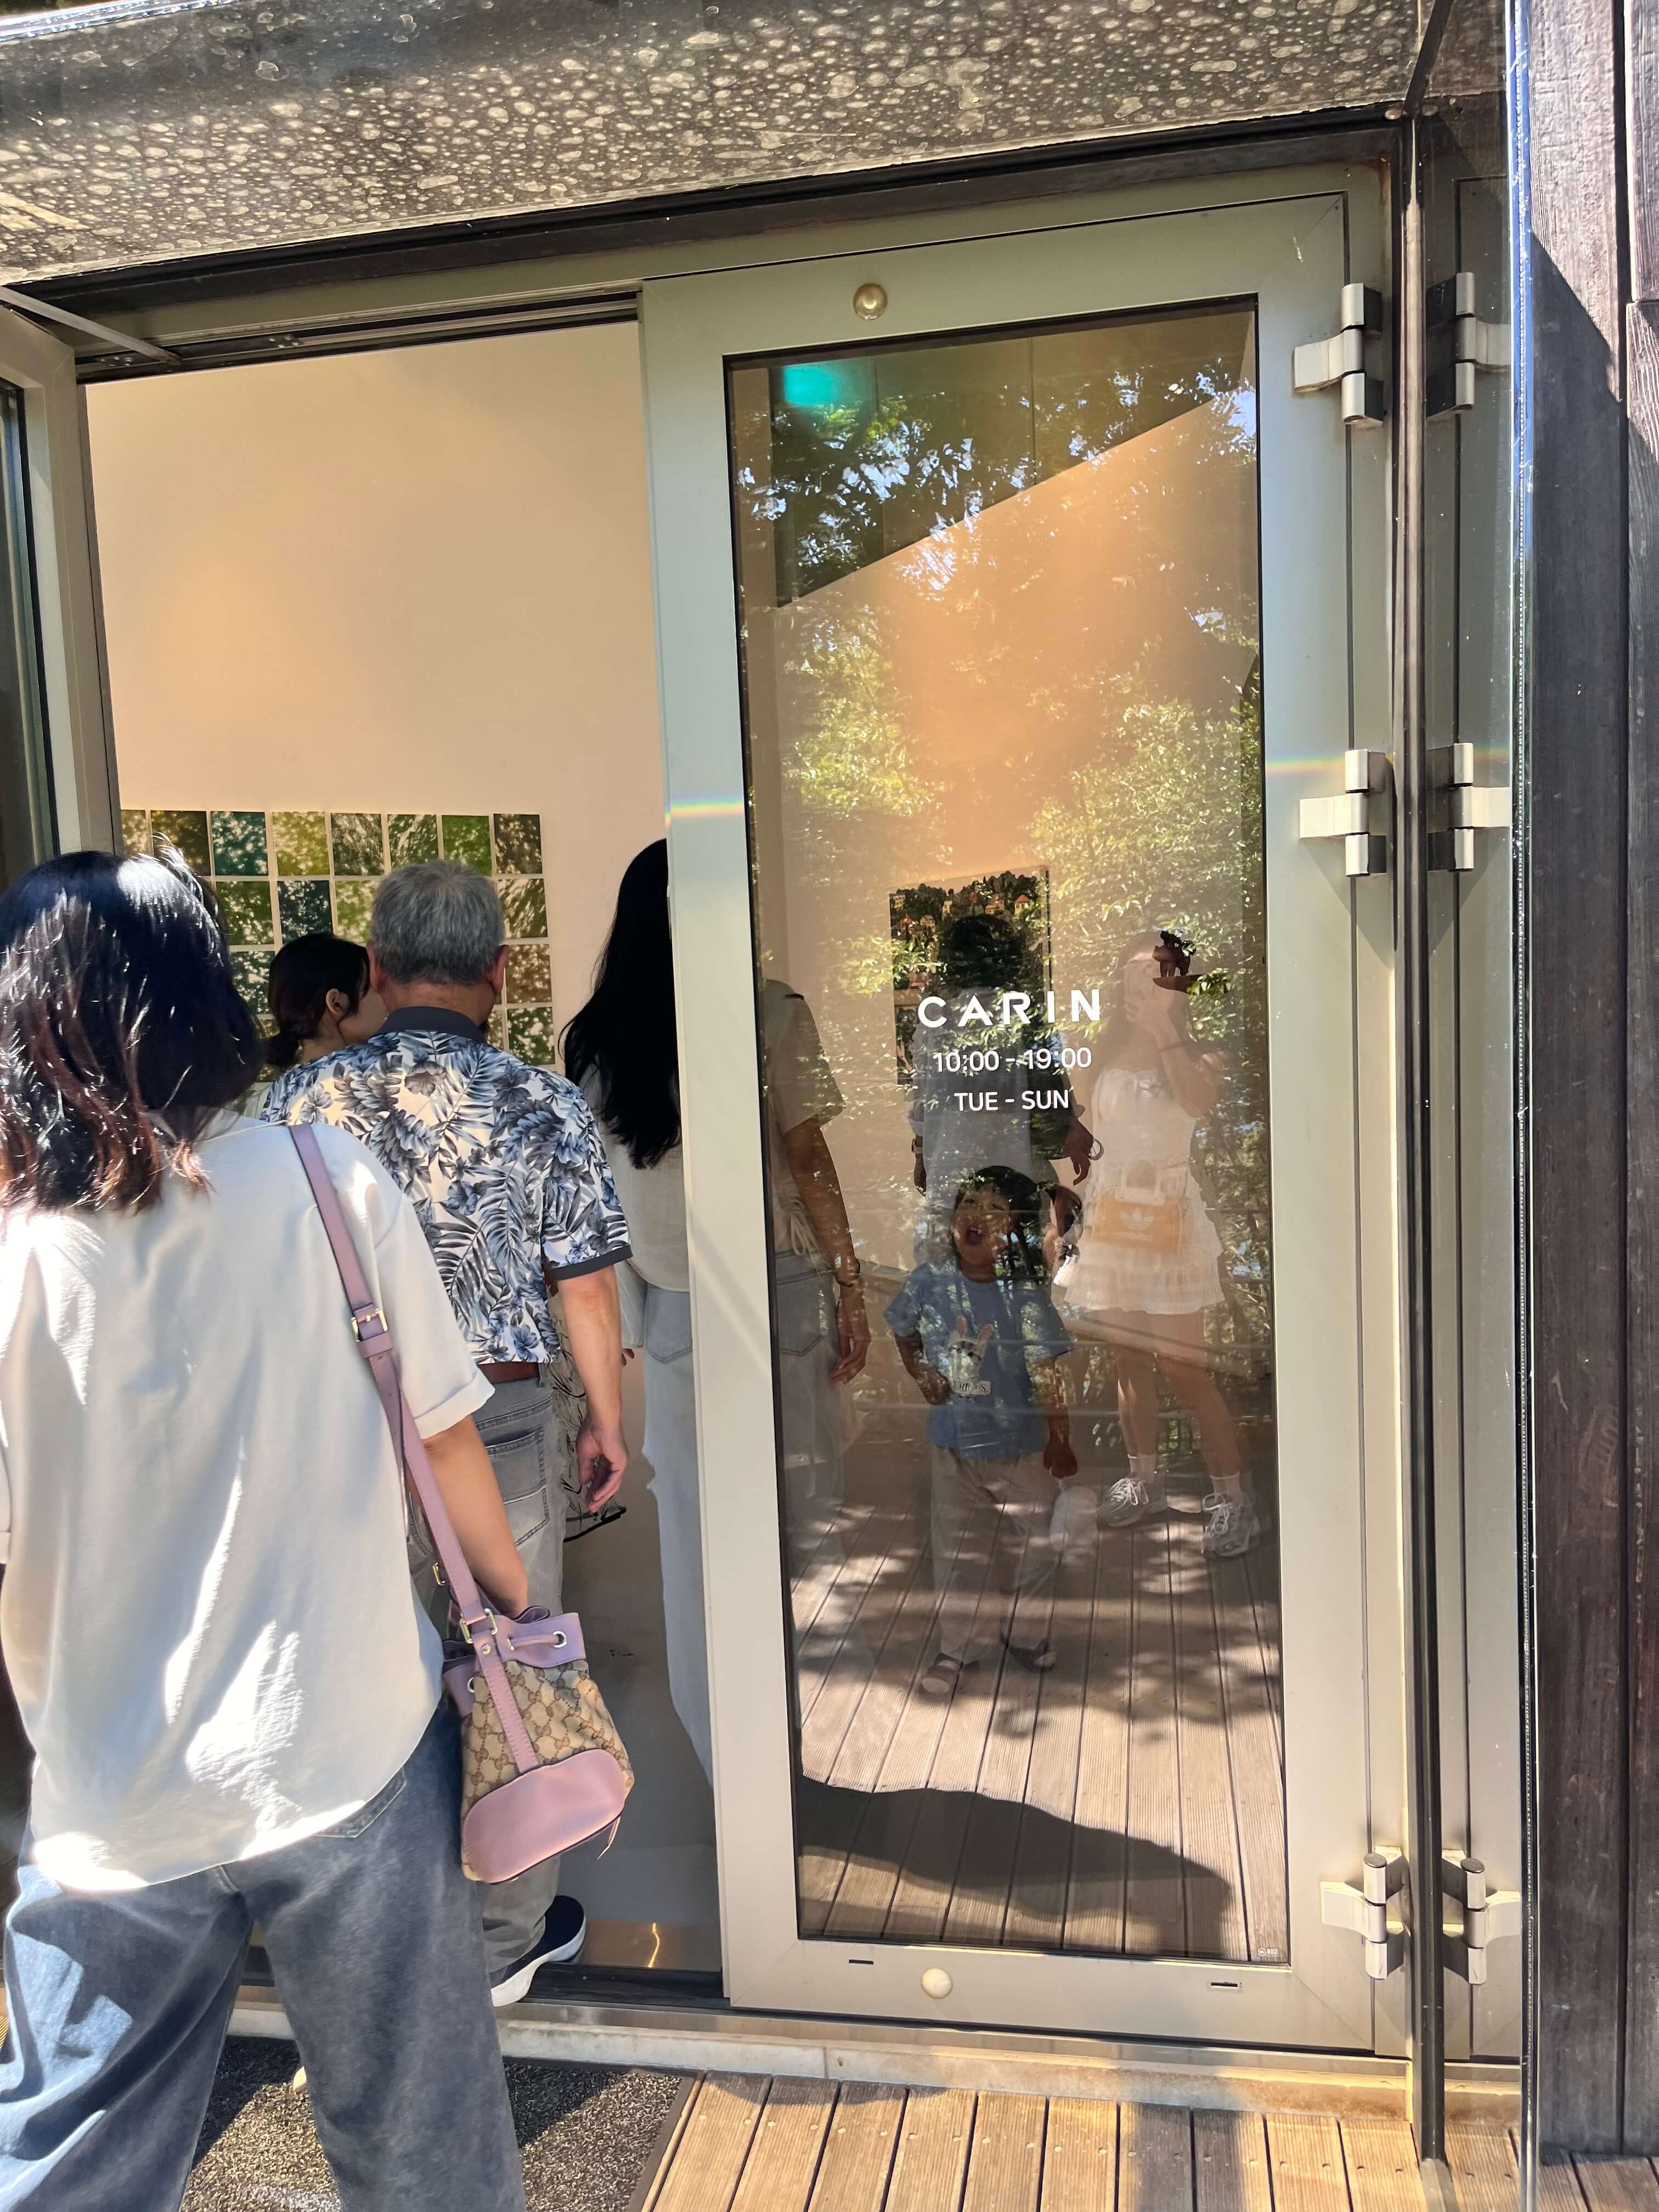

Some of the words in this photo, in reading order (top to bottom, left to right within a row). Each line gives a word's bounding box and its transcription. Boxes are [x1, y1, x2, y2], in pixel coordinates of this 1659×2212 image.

[918, 989, 1101, 1028] CARIN
[933, 1050, 999, 1072] 10:00
[1024, 1047, 1092, 1069] 19:00
[955, 1092, 998, 1111] TUE
[1022, 1090, 1069, 1110] SUN
